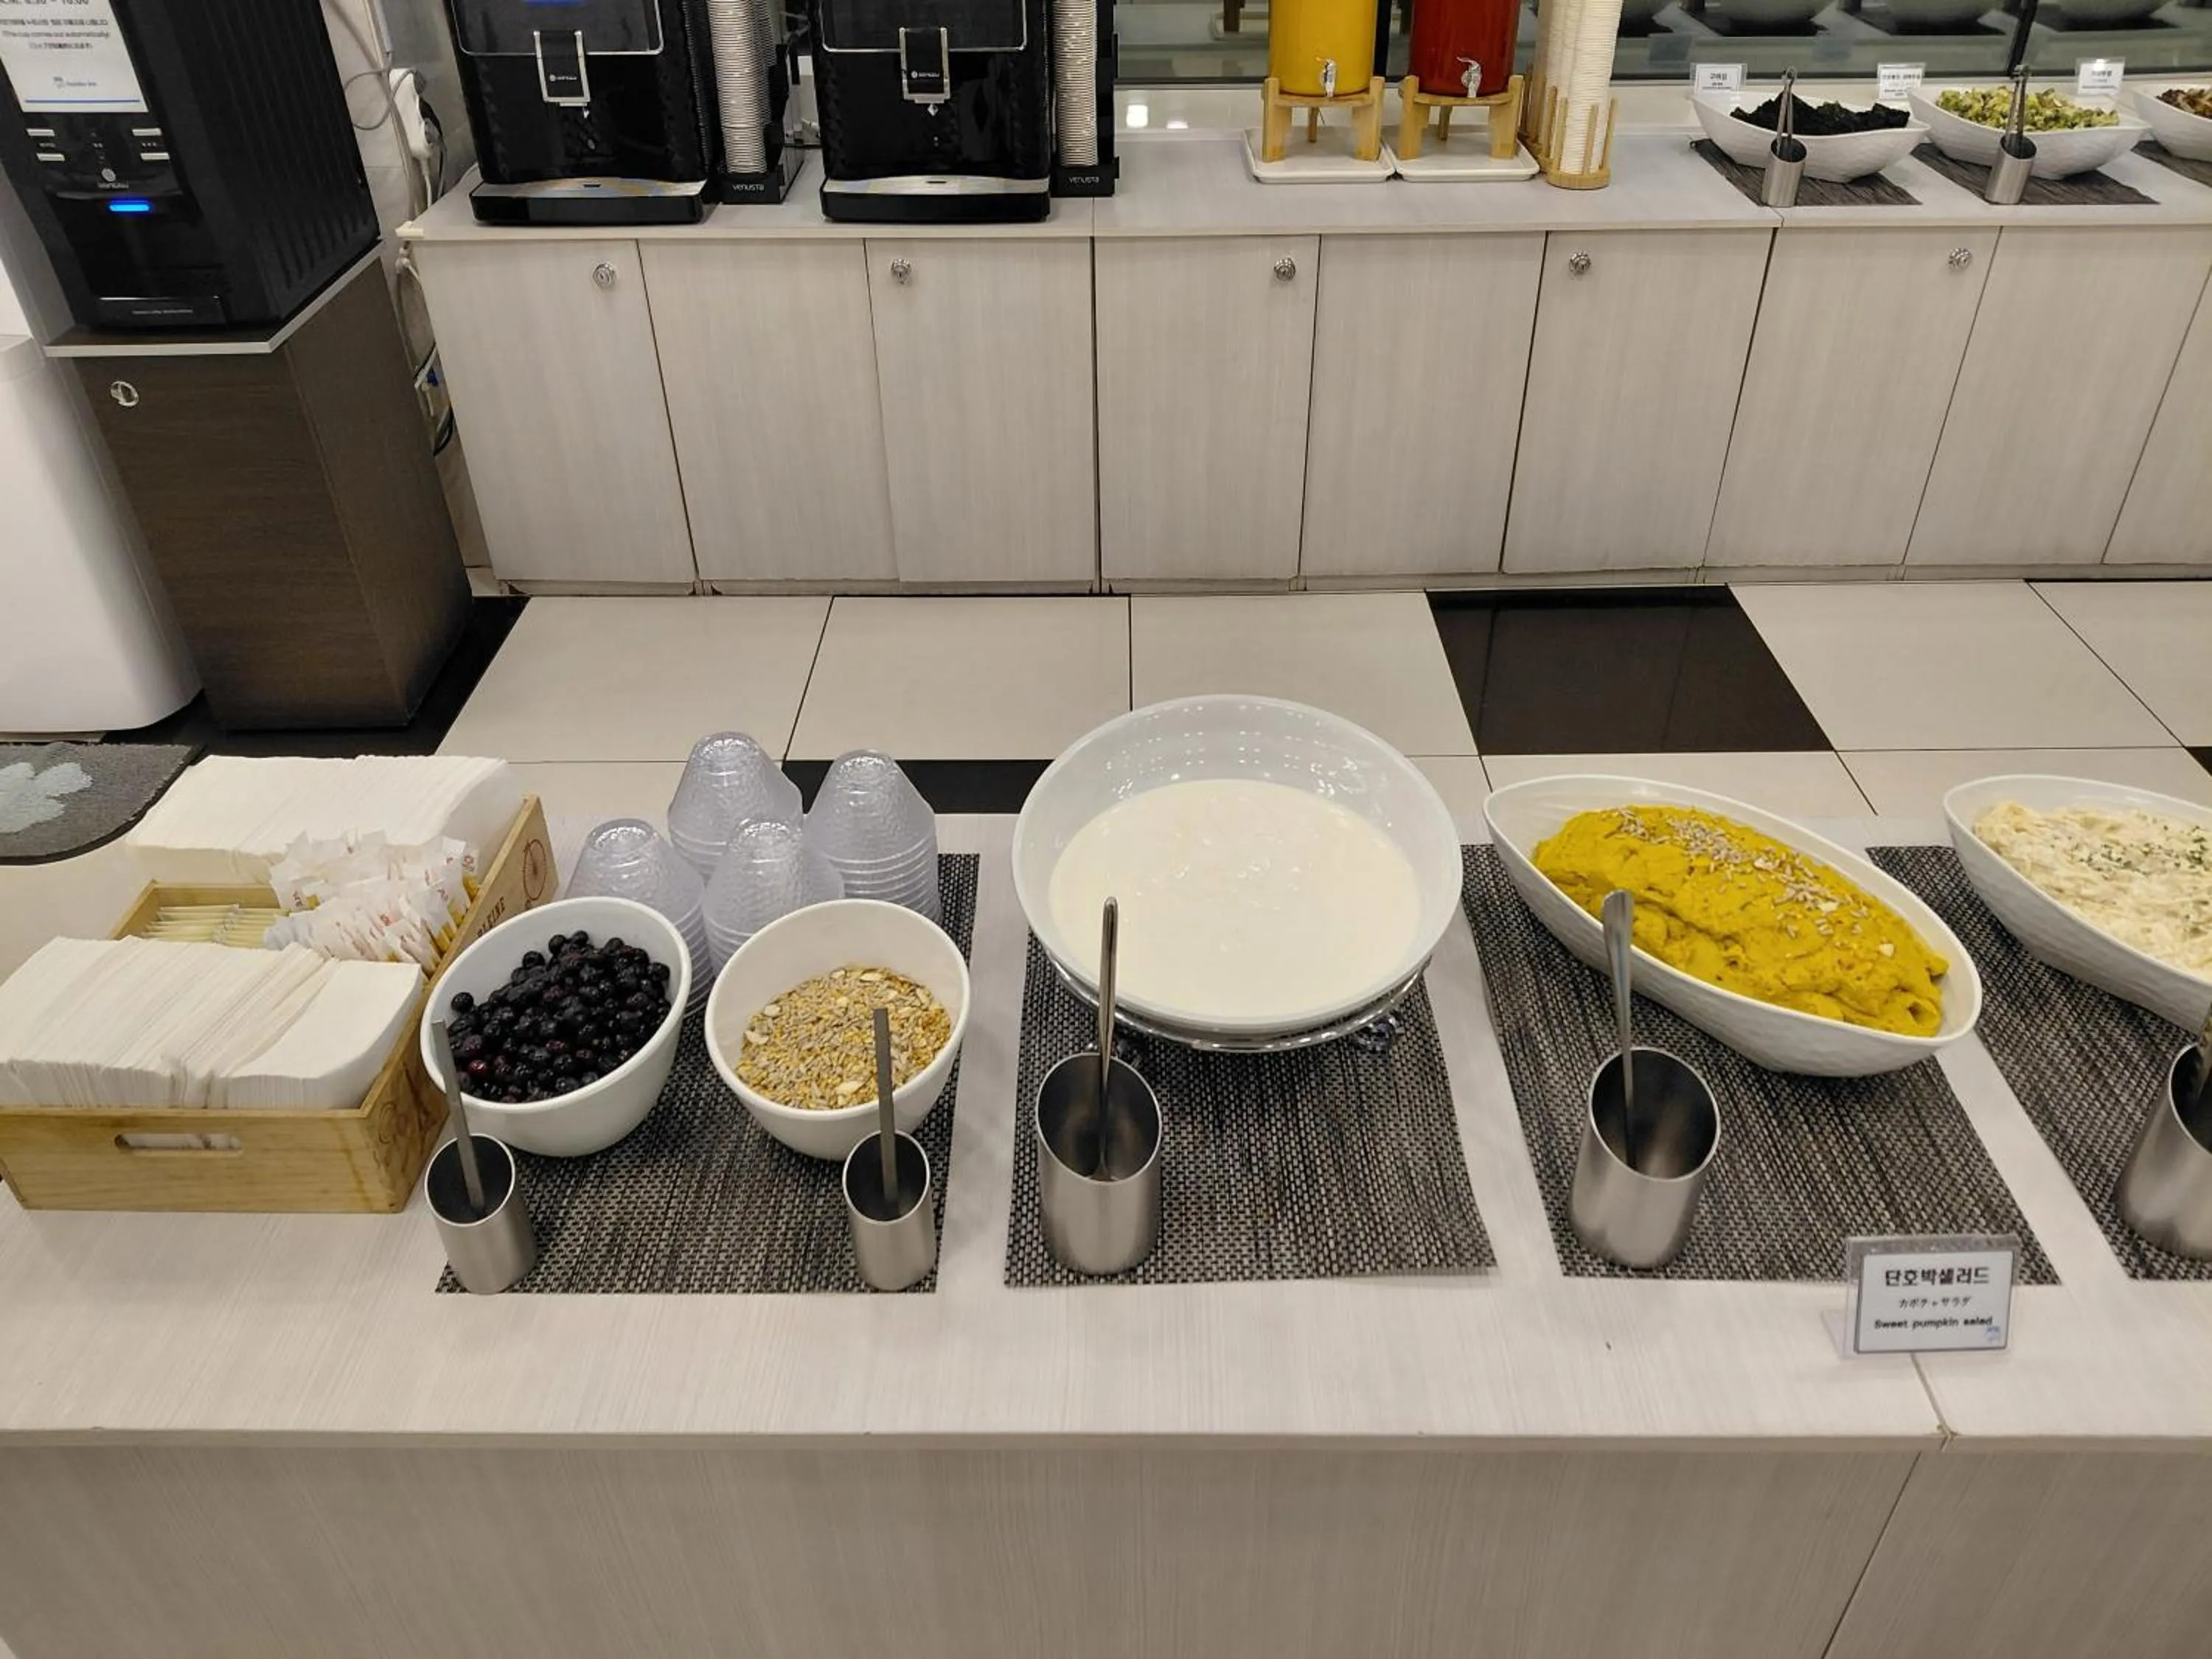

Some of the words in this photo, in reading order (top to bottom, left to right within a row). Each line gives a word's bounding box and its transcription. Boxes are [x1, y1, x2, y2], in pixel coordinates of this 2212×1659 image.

[1885, 1266, 1990, 1287] 단호박샐러드
[1899, 1295, 1972, 1310] カボチャサラダ
[1874, 1319, 1908, 1329] Sweet
[1912, 1317, 1959, 1330] pumpkin
[1963, 1316, 1993, 1326] salad
